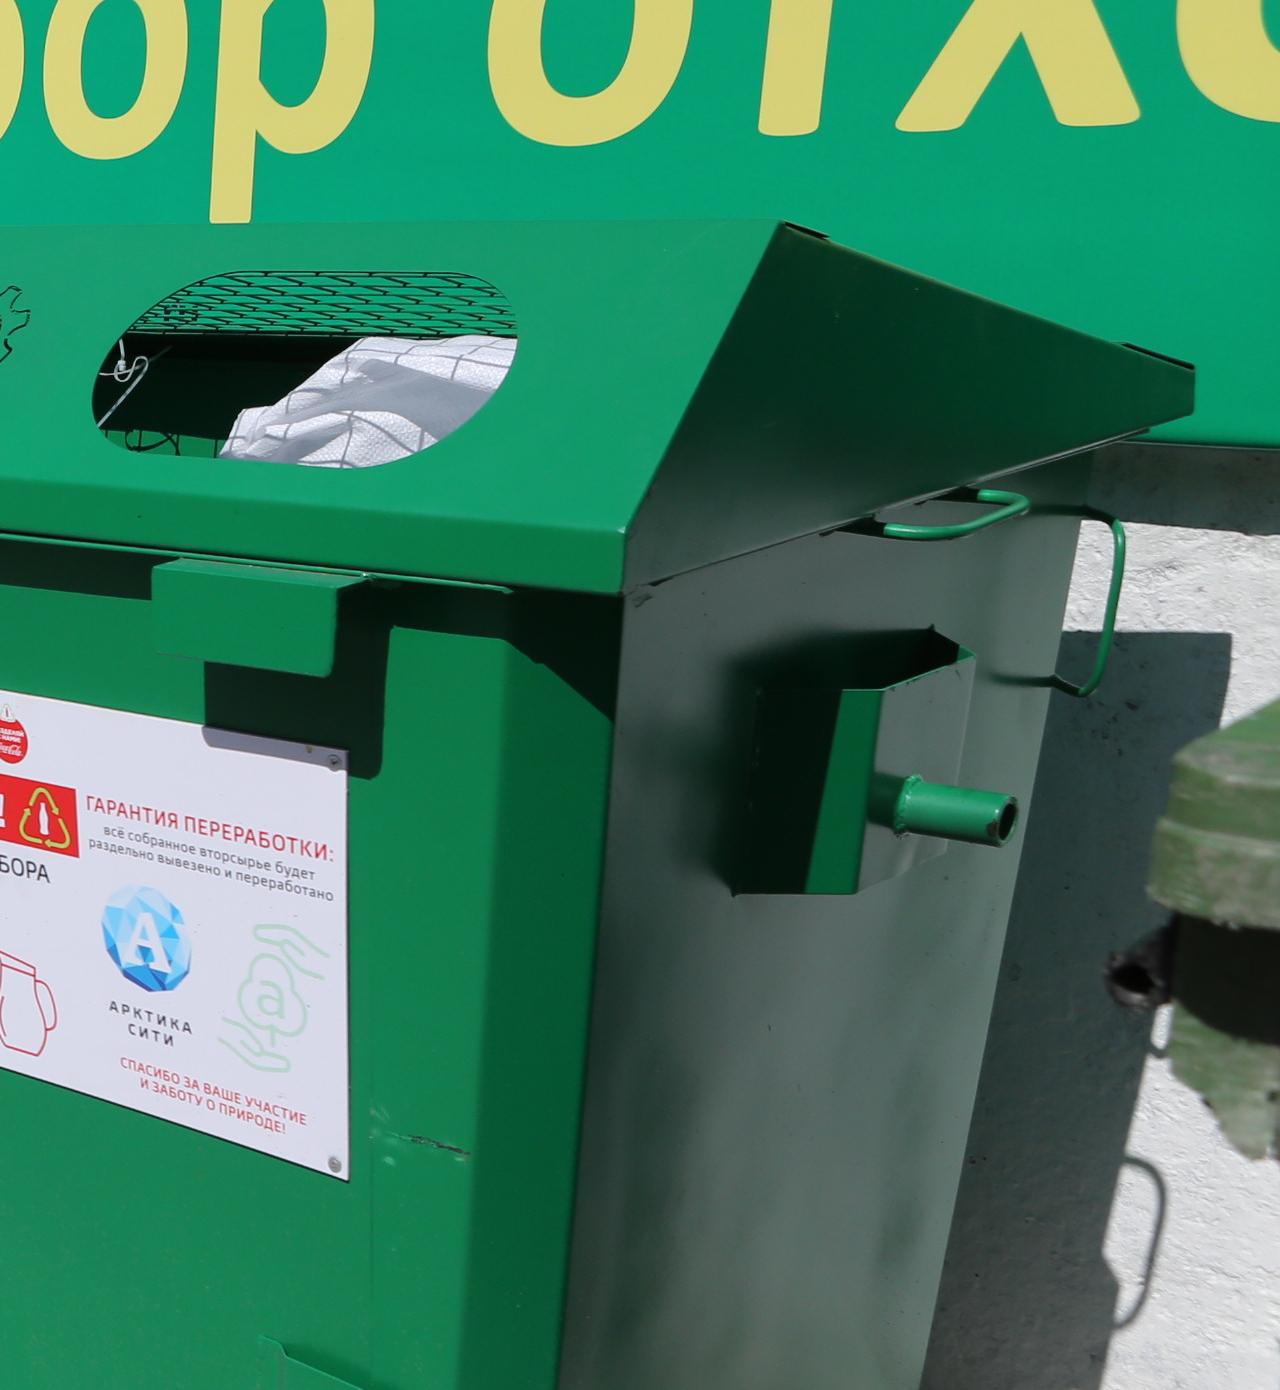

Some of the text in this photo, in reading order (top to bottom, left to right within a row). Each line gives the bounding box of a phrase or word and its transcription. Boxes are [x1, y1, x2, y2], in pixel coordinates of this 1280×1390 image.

[86, 795, 334, 862] ГАРАНТИЯ ПЕРЕРАБОТКИ:
[103, 825, 315, 882] всё собранное вторсырье будет
[89, 837, 334, 902] раздельно вывезено и переработано
[108, 1000, 193, 1035] АРКТИКА
[128, 1023, 174, 1047] СИТИ
[120, 1057, 307, 1126] СПАСИБО ЗА ВАШЕ УЧАСТИЕ
[140, 1078, 286, 1134] И ЗАБОТУ О ПРИРОДЕ!
